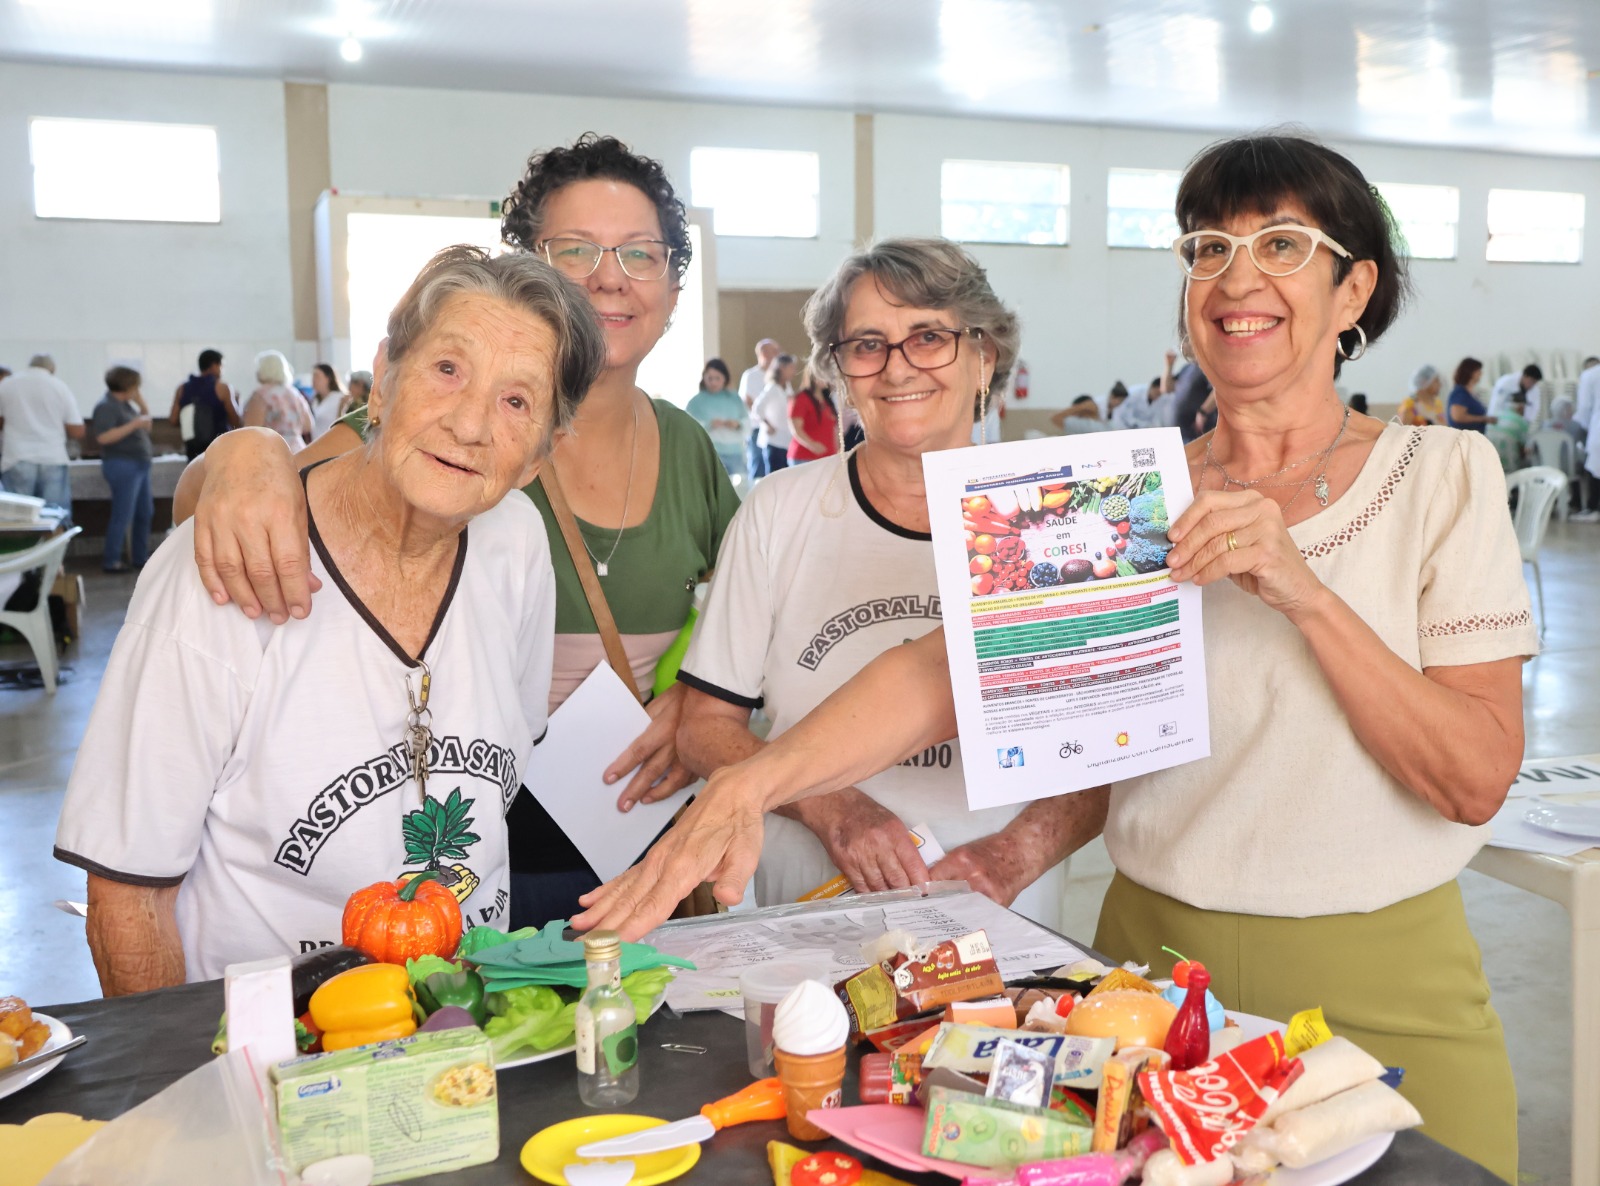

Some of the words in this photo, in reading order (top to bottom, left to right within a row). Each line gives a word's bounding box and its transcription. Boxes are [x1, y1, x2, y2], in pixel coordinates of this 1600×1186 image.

[1056, 531, 1071, 540] em
[1043, 542, 1087, 558] CORES!
[797, 595, 928, 671] PASTORAL
